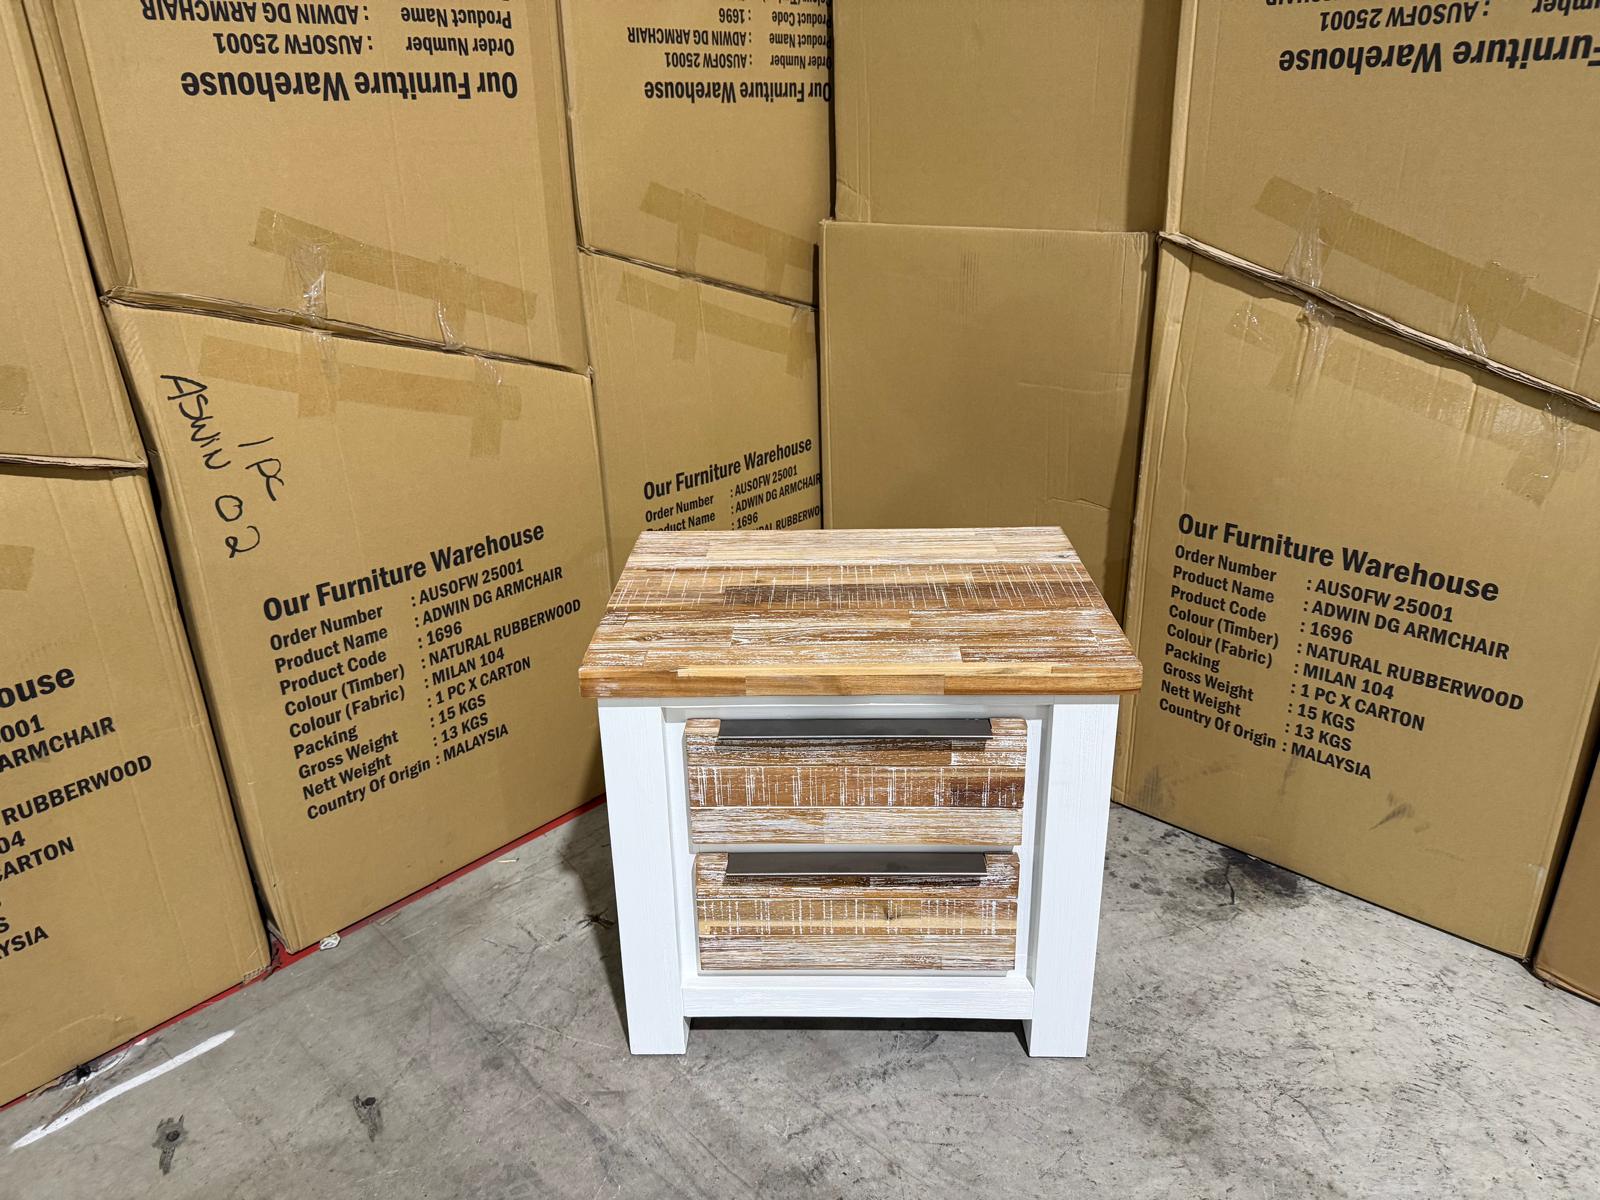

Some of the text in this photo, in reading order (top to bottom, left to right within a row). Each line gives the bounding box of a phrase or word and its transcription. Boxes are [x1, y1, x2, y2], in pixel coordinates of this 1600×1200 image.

[140, 0, 512, 29] Product Name ADWIN DG ARMCHAIR
[627, 27, 691, 45] ARMCHAIR
[693, 30, 709, 45] DG
[712, 30, 746, 46] ADWIN
[719, 8, 745, 24] 1696
[769, 33, 795, 48] Name
[772, 11, 795, 26] Code
[1320, 8, 1383, 31] 25001
[1385, 1, 1479, 27] AUSOFW
[213, 33, 514, 56] Order Number AUSOFW 25001
[664, 52, 700, 68] 25001
[703, 53, 747, 68] AUSOFW
[770, 55, 806, 69] Number
[1279, 43, 1442, 75] Warehouse
[181, 72, 518, 102] Our Furniture Warehouse
[644, 81, 832, 104] Our Furniture Warehouse
[644, 439, 812, 500] Our Furniture Warehouse
[645, 465, 797, 523] Order Number AUSOFW 25001
[646, 472, 822, 531] oduct Name ADWIN DG ARMCHAIR
[737, 512, 758, 530] 1696
[775, 505, 821, 531] RUBBERWO
[263, 525, 544, 621] Our Furniture Warehouse
[1175, 545, 1453, 623] Order Number AUSOFW 25001
[1179, 513, 1499, 601] Our Furniture Warehouse
[270, 558, 524, 651] Order Number AUSOFW 25001
[275, 566, 563, 674] Product Name ADWIN DG ARMCHAIR
[1171, 585, 1353, 644] Product Code 1696
[1173, 565, 1509, 660] Product Name ADWIN DG ARMCHAIR
[279, 621, 462, 695] Product Code 1696
[285, 599, 581, 716] Colour (Timber) NATURAL RUBBERWOOD
[1167, 624, 1394, 700] Colour (Fabric) MILAN 104
[1169, 604, 1523, 710] Colour (Timber) NATURAL RUBBERWOOD
[289, 647, 504, 738] Colour (Fabric) MILAN 104
[294, 656, 530, 759] Packing 1 PC X CARTON
[1161, 679, 1352, 751] Nett Weight 13 KGS
[1163, 662, 1355, 732] Gross Weight 15 KGS
[1165, 643, 1425, 731] Packing 1 PC X CARTON
[0, 717, 116, 773] ARMCHAIR
[299, 694, 486, 779] Gross Weight 15 KGS
[302, 712, 488, 800] Nett Weight 13 KGS
[1159, 698, 1371, 779] Country Of Origin MALAYSIA
[1, 755, 151, 826] RUBBERWOOD
[307, 724, 509, 819] Country Of Origin MALAYSIA
[0, 837, 74, 882] ARTON
